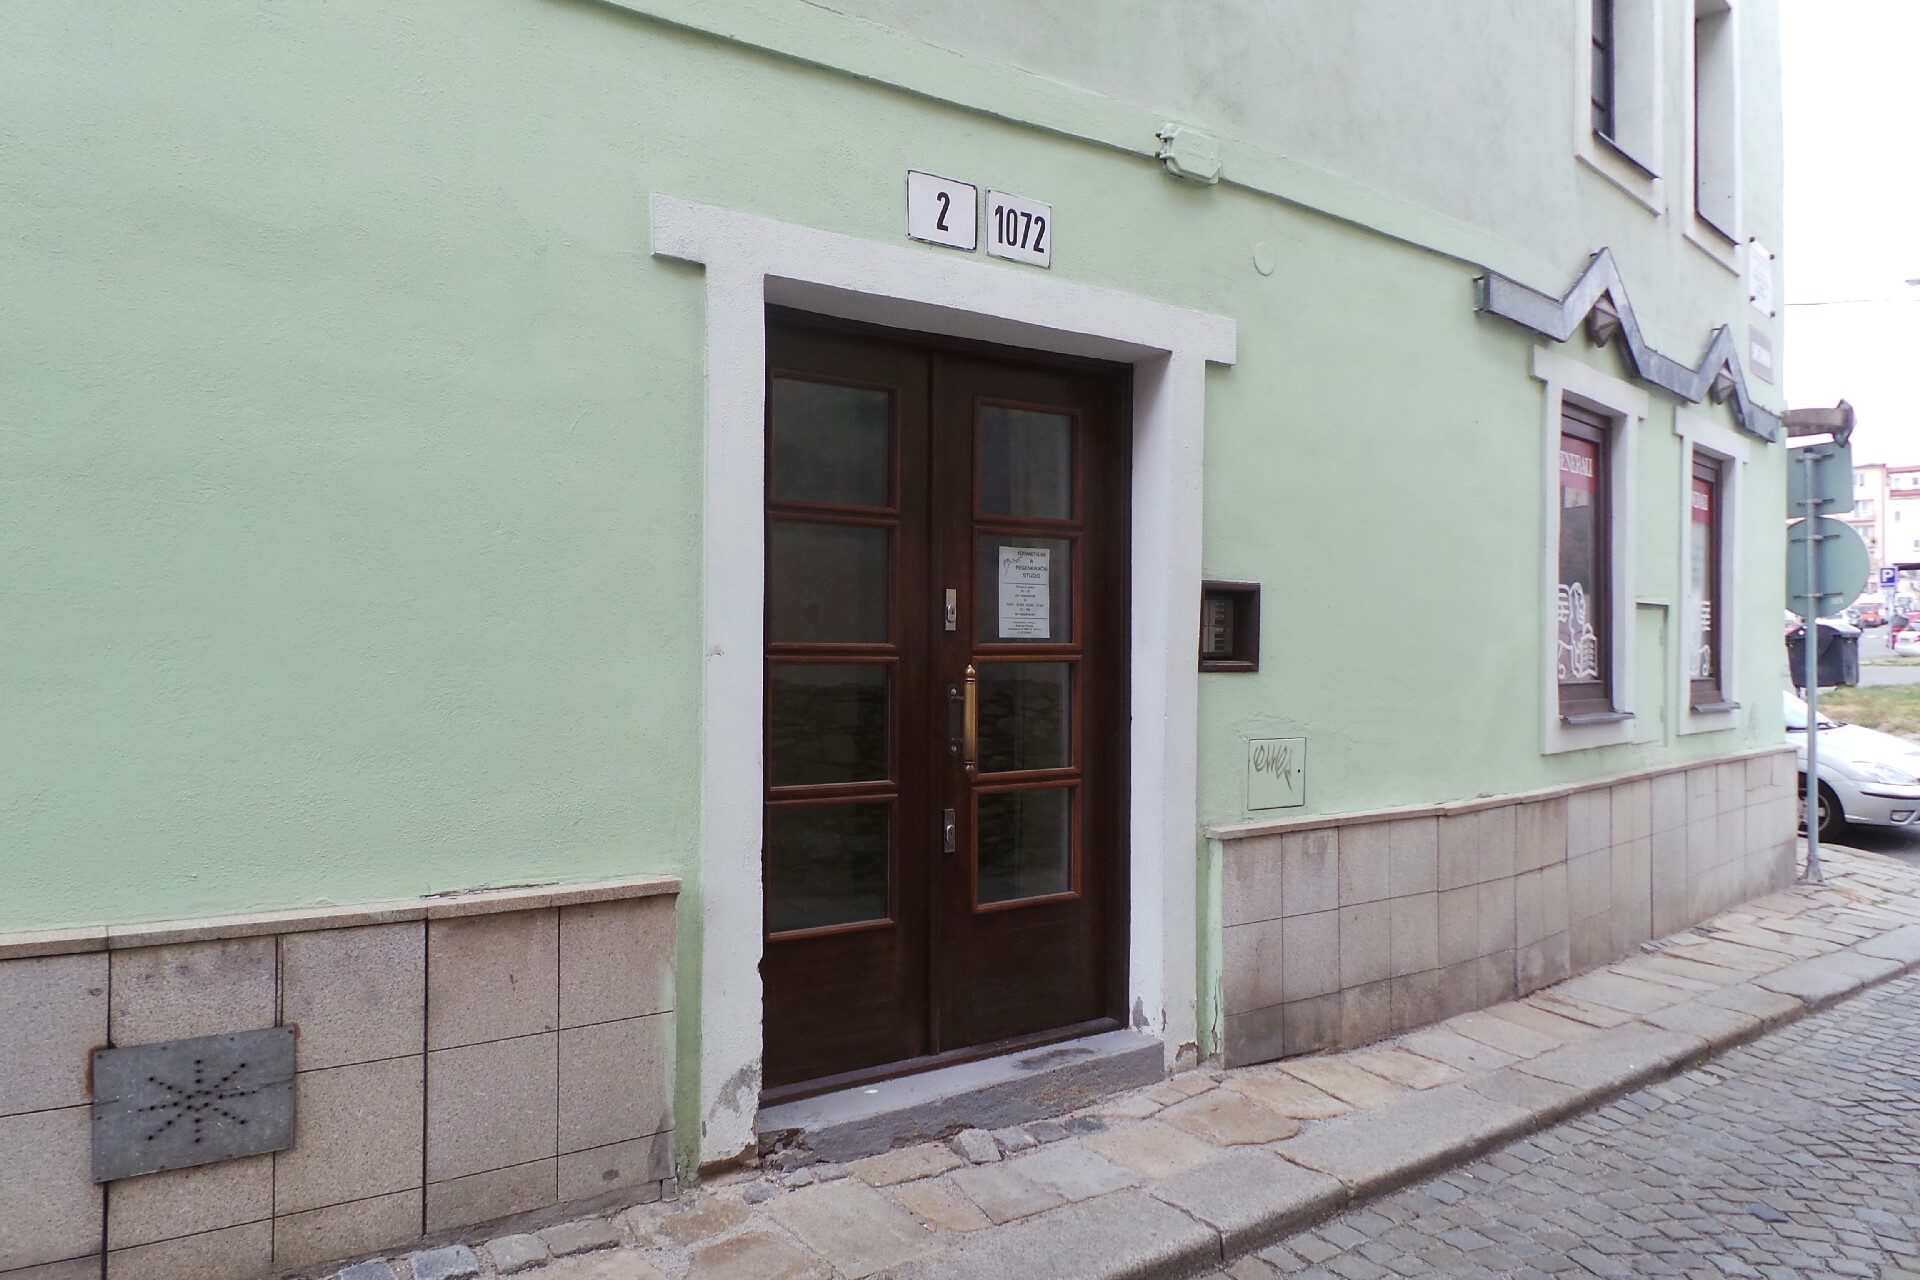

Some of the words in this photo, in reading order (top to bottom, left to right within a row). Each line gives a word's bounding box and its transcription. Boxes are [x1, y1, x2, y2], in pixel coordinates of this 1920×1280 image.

[936, 191, 951, 232] 2
[994, 205, 1046, 254] 1072
[1882, 569, 1894, 582] P
